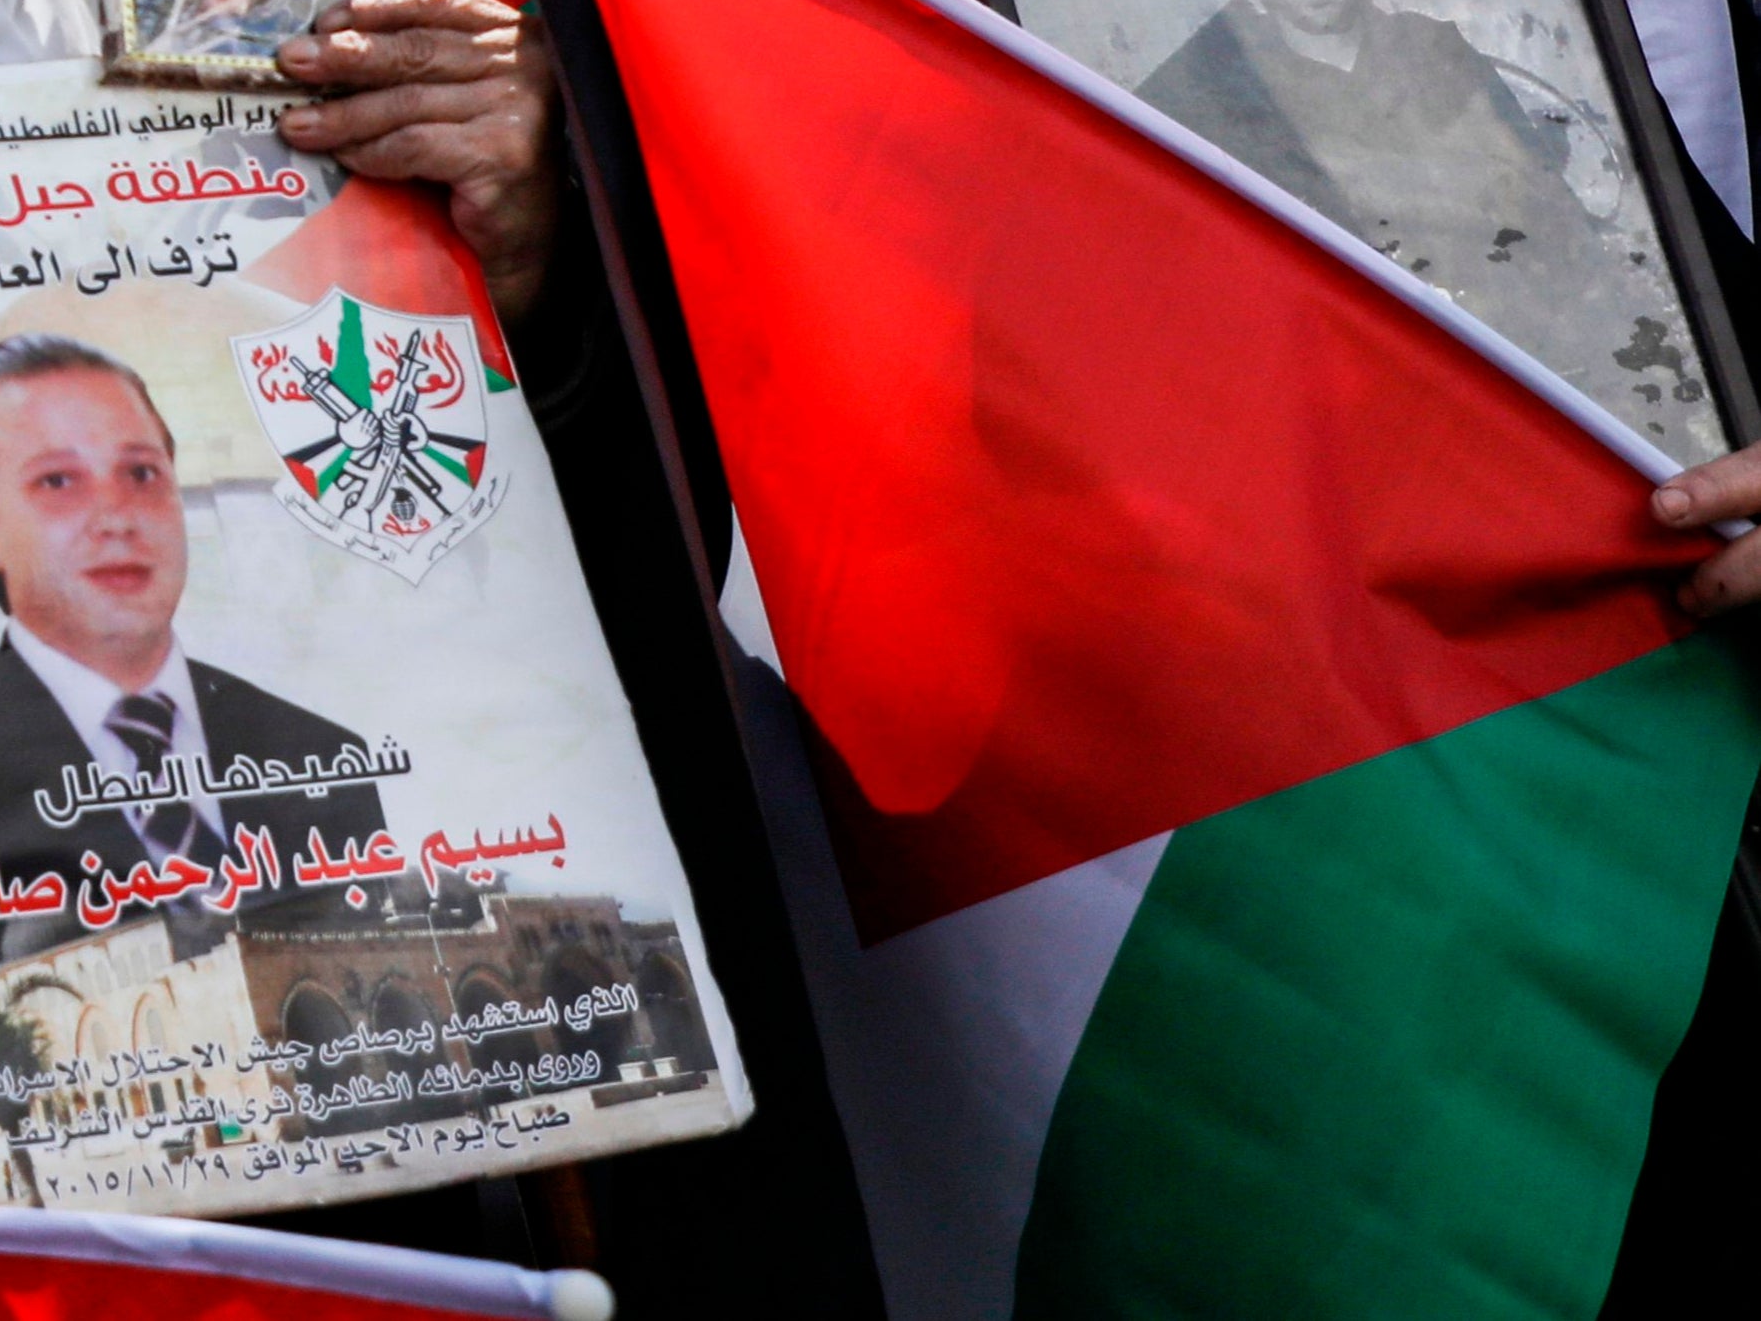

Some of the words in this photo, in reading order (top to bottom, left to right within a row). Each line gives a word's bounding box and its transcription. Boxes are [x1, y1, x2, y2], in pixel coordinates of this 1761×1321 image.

[129, 96, 235, 141] الوطني
[106, 157, 307, 204] منطقة
[77, 238, 138, 295] الى
[149, 232, 241, 288] تزف
[34, 753, 190, 826] البطل
[194, 734, 412, 800] شهيدها
[78, 823, 280, 928] الرحمن
[293, 828, 406, 908] عبد
[418, 813, 566, 892] بسيم
[442, 998, 558, 1044] استشهد
[564, 984, 638, 1032] الذي
[235, 1036, 314, 1072] جيش
[319, 1022, 435, 1065] برصاص
[133, 1097, 227, 1139] القدس
[433, 1119, 485, 1154] يوم
[492, 1108, 571, 1149] صباح
[242, 1142, 328, 1180] الموافق
